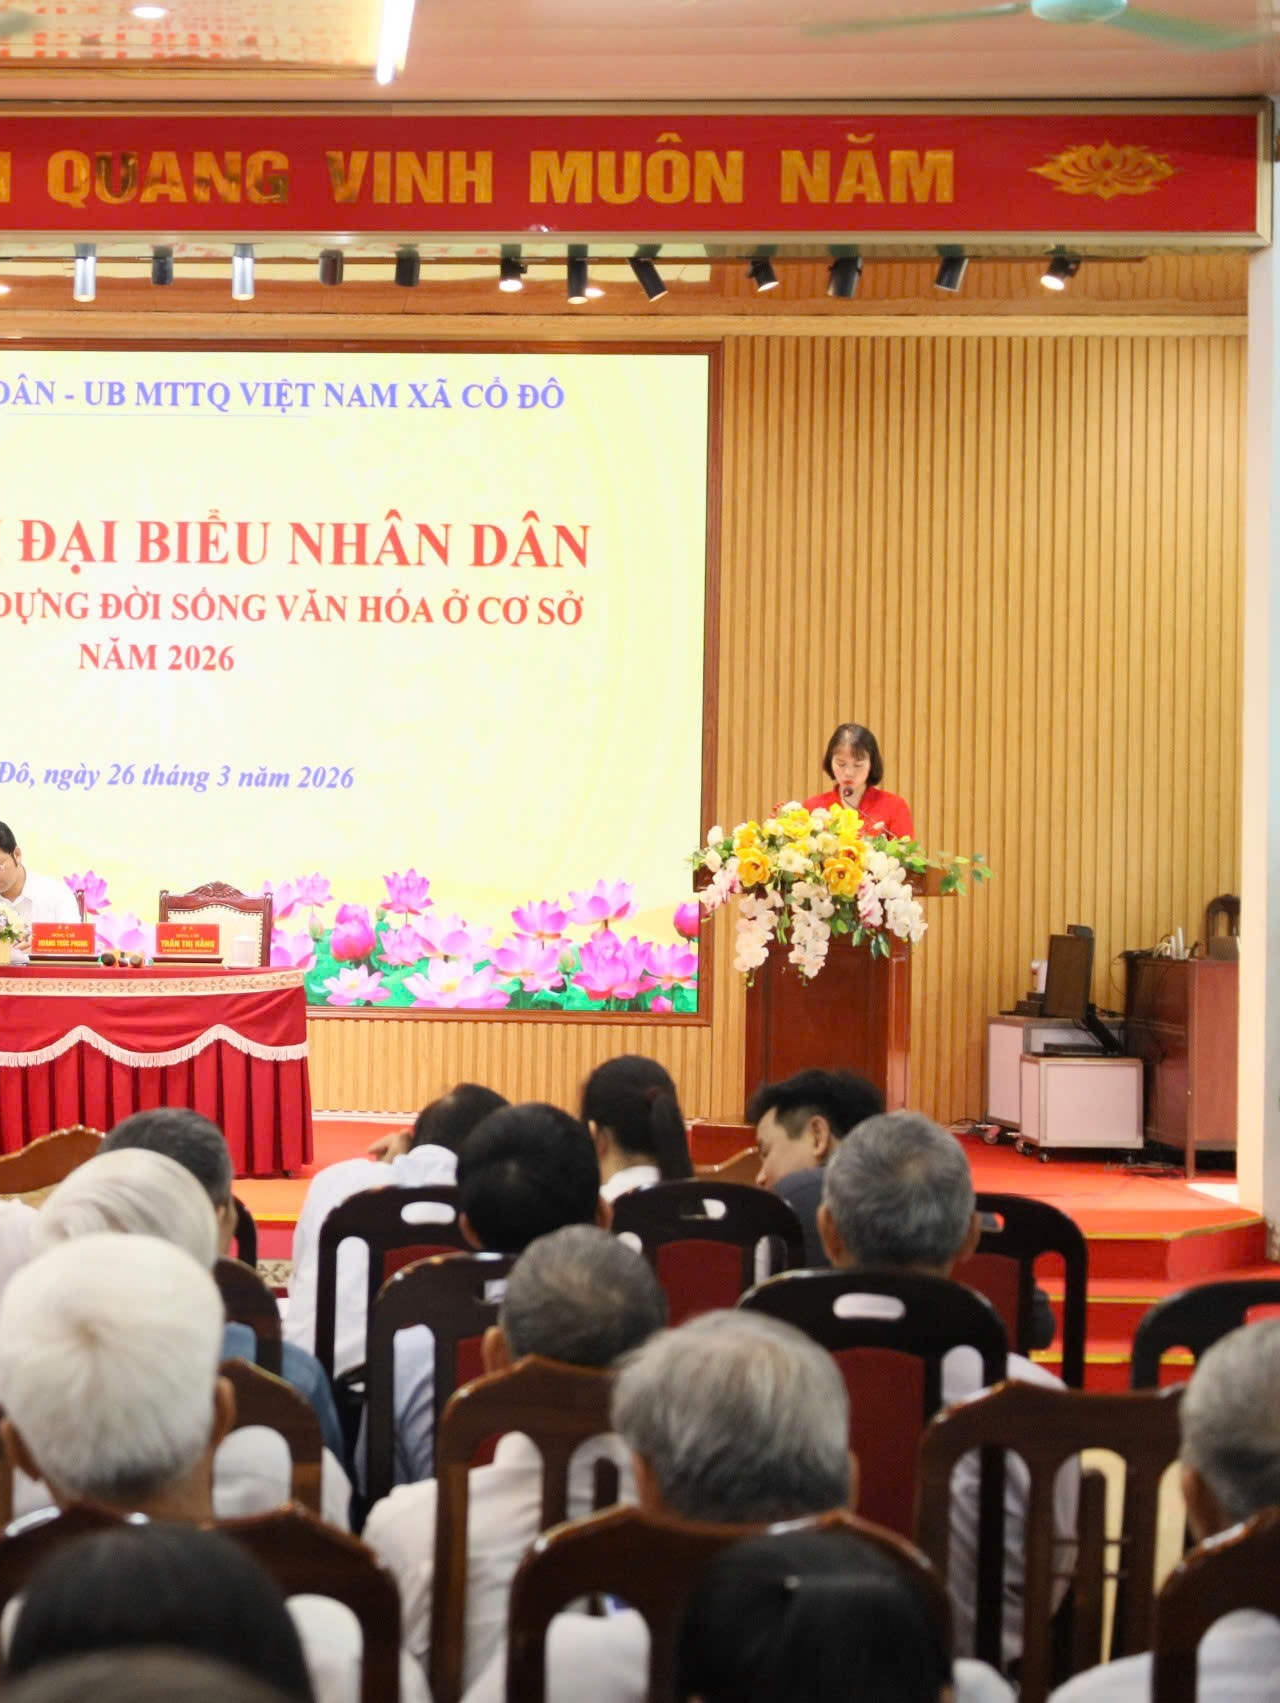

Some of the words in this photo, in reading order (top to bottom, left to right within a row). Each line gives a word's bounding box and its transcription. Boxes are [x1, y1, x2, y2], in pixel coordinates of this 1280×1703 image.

[47, 150, 290, 209] QUANG
[326, 150, 493, 205] VINH
[529, 133, 744, 205] MUÔN
[780, 133, 955, 204] NĂM
[83, 380, 127, 407] UB
[135, 381, 231, 412] MTTQ
[238, 379, 316, 414] VIỆT
[323, 382, 399, 408] NAM
[407, 378, 453, 409] XÃ
[461, 376, 509, 409] CỔ
[517, 377, 565, 409] ĐÔ
[17, 519, 118, 575] ĐẠI
[135, 508, 271, 566] BIỂU
[288, 508, 453, 568] NHÂN
[468, 509, 591, 568] DÂN
[99, 584, 161, 620] ĐỜI
[171, 587, 267, 622] SỐNG
[277, 587, 347, 623] VĂN
[357, 587, 434, 624] HÓA
[442, 589, 469, 625] Ở
[478, 593, 529, 625] CƠ
[537, 590, 584, 625] SỞ
[78, 636, 157, 670] NĂM
[168, 644, 235, 671] 2026
[42, 762, 101, 792] ngày
[106, 763, 137, 787] 26
[141, 763, 211, 794] tháng
[216, 764, 232, 788] 3
[237, 765, 291, 789] năm
[296, 765, 356, 790] 2026
